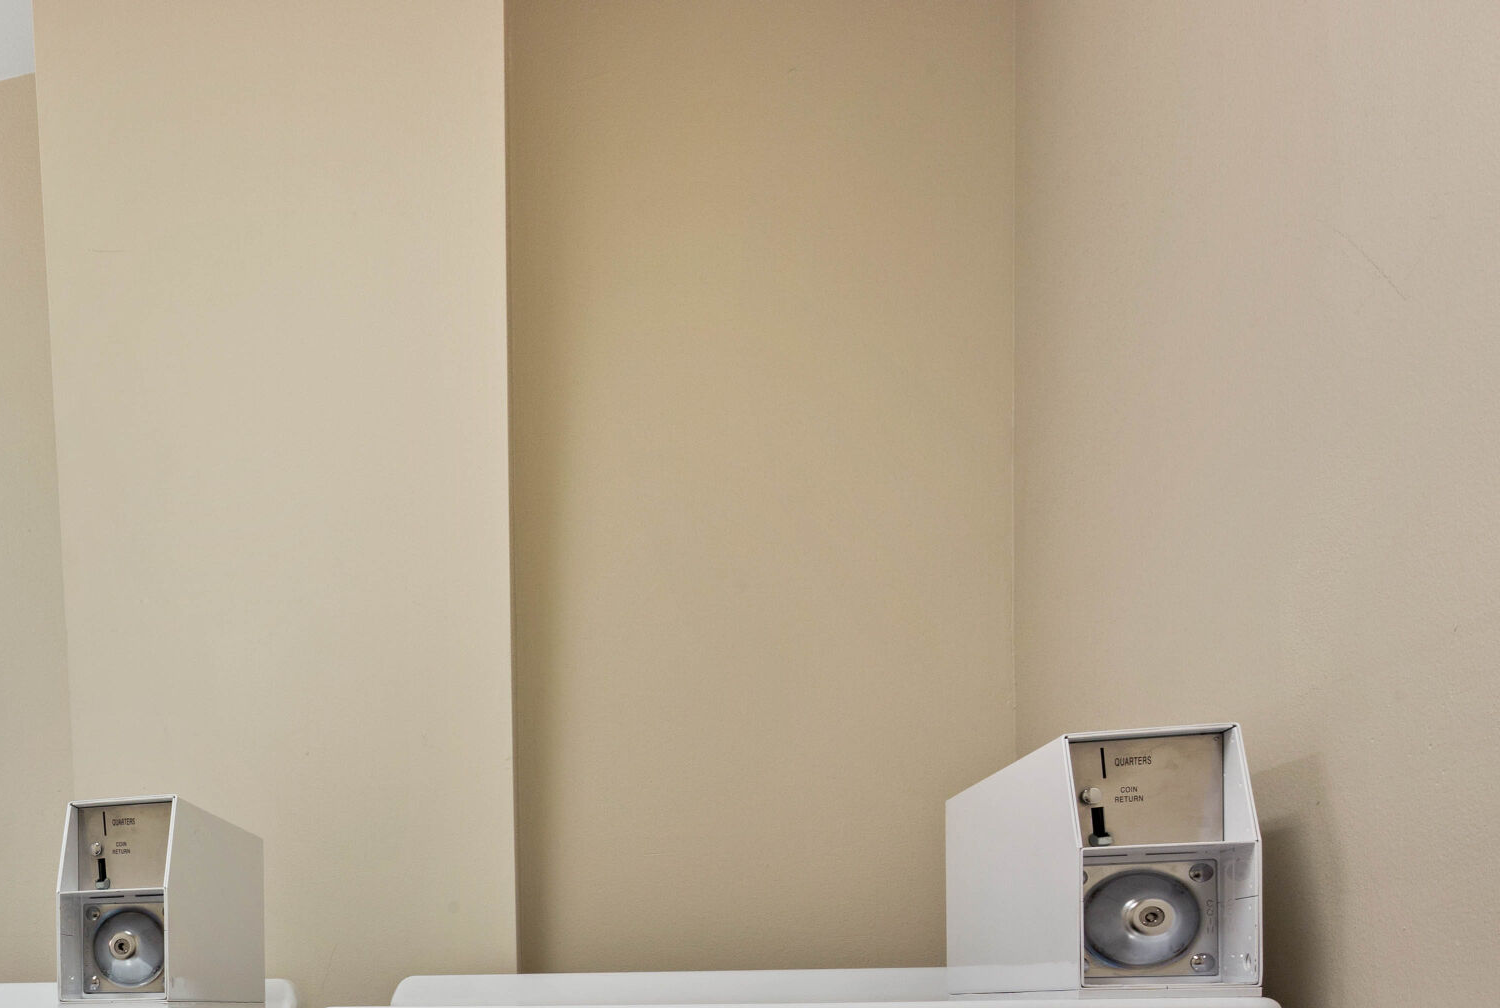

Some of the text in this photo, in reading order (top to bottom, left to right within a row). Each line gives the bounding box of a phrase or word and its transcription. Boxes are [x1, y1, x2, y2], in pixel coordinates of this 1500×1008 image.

[1114, 755, 1152, 766] QUARTERS
[1120, 786, 1138, 794] COIN
[1114, 794, 1144, 803] RETURN
